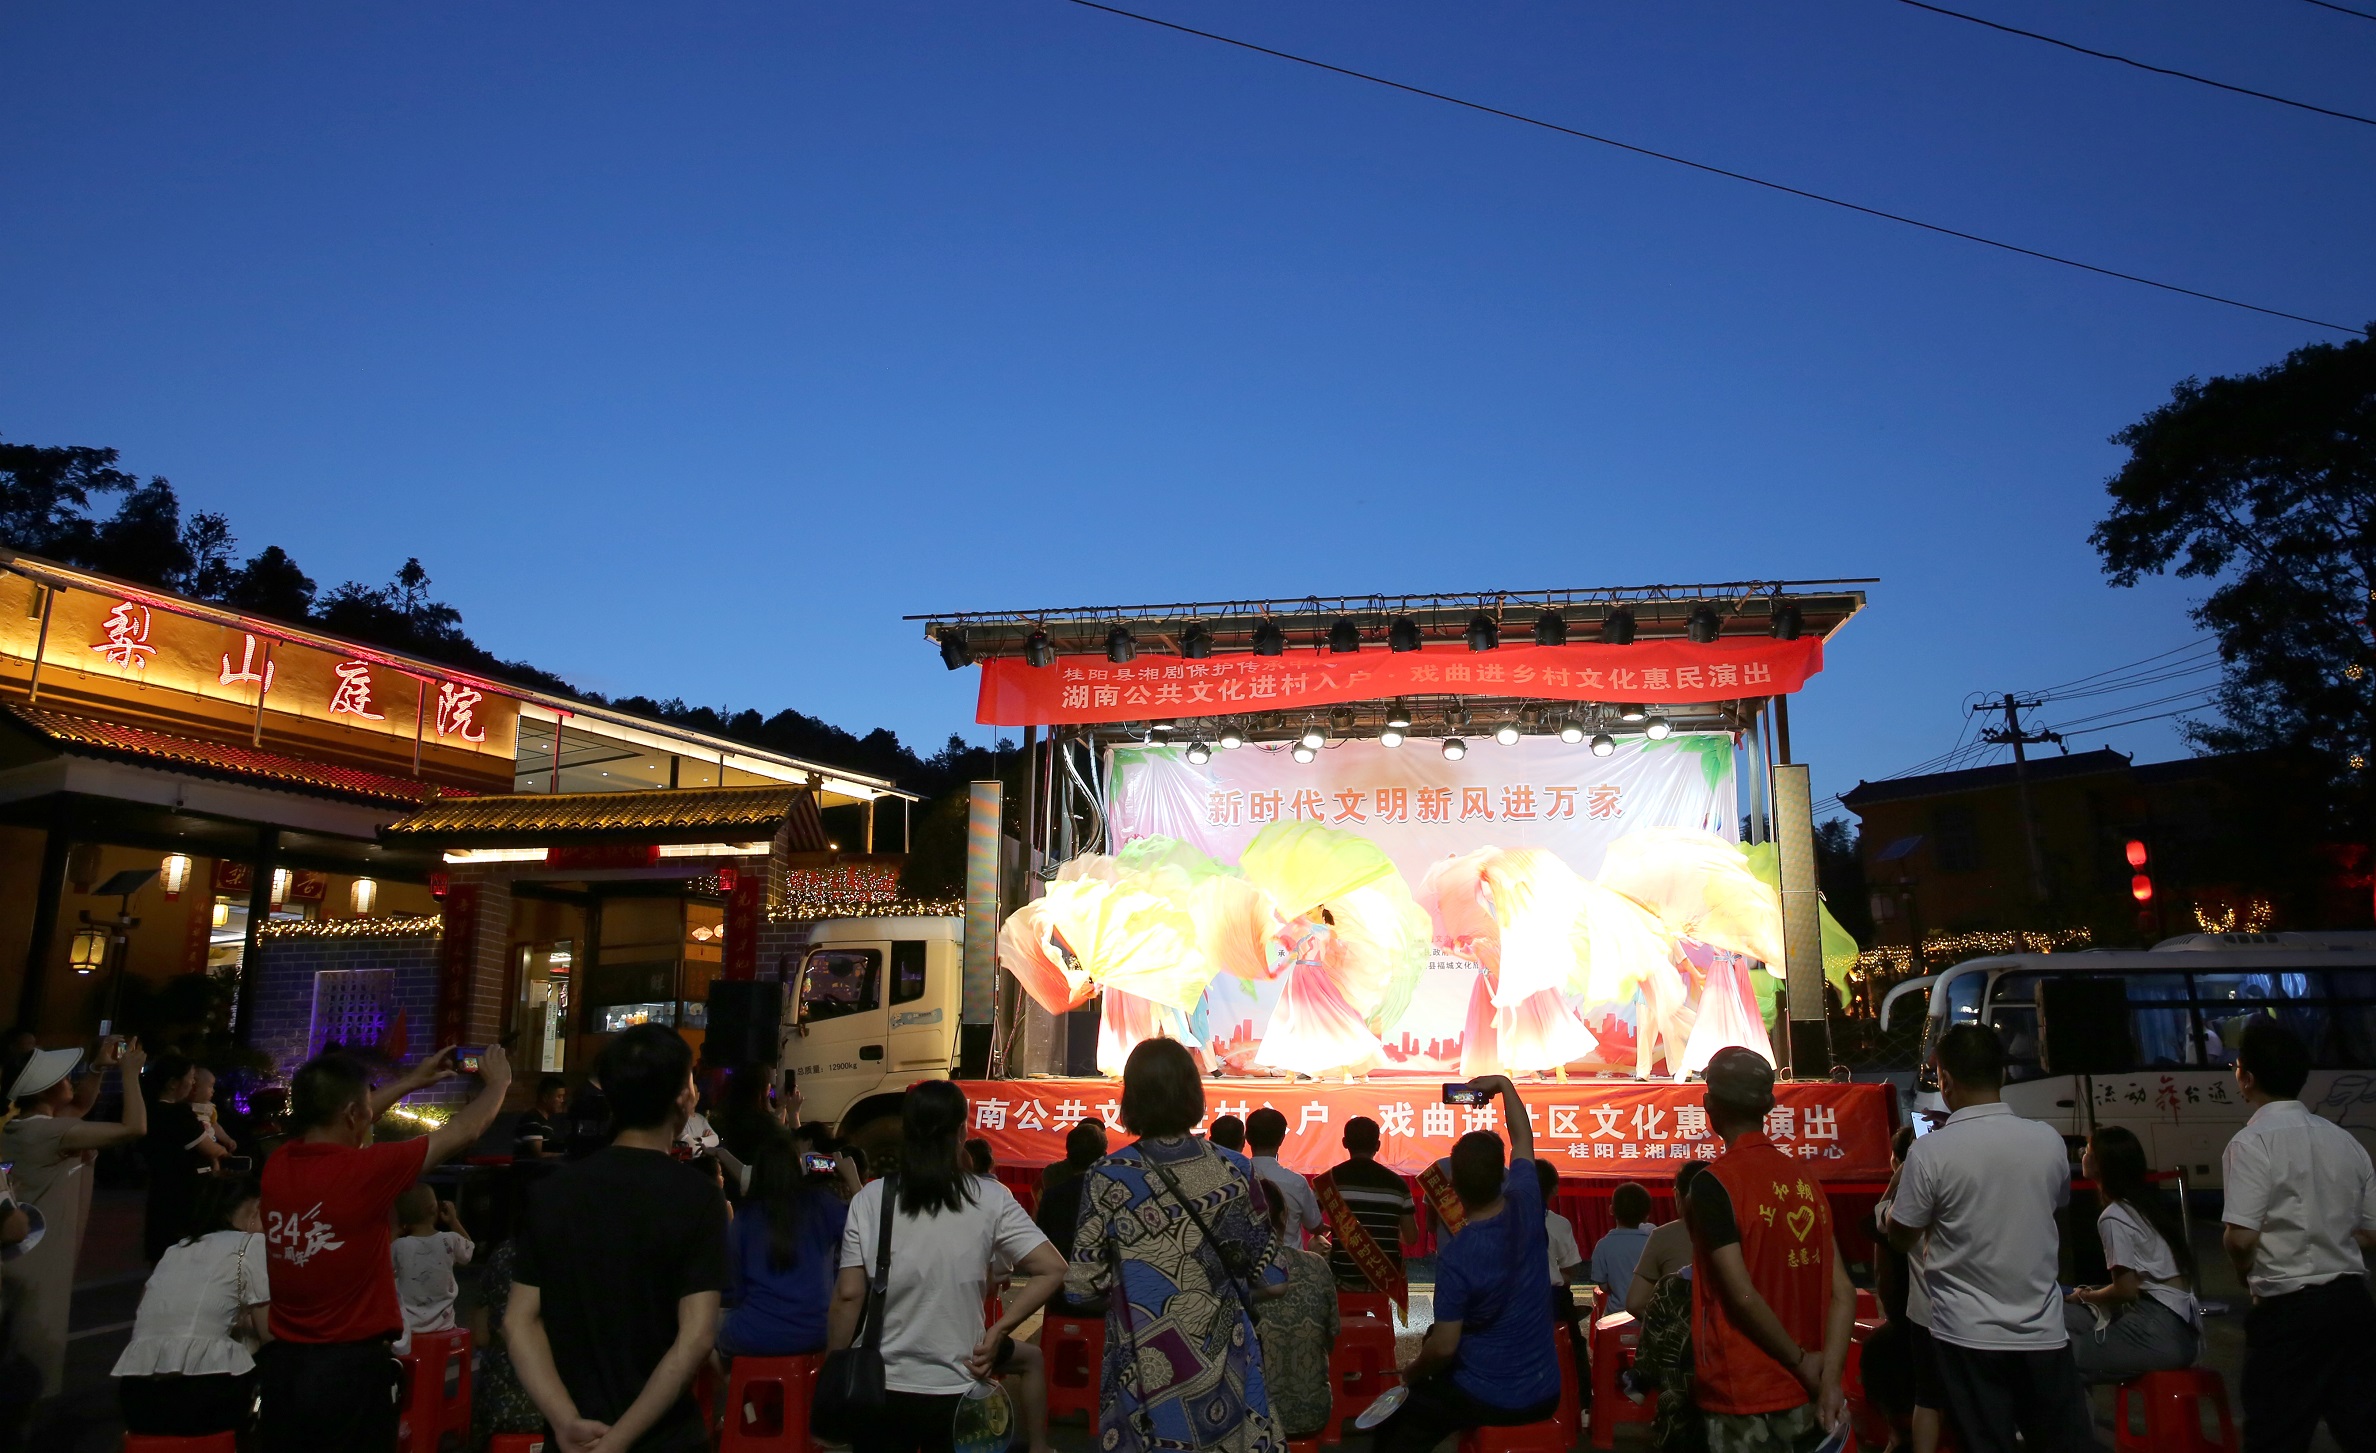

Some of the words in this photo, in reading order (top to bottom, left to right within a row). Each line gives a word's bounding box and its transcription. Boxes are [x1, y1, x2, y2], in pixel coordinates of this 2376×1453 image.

[1206, 785, 1626, 826] 新时代文明新风进万家
[2095, 1075, 2250, 1127] 流动舞台通
[268, 1211, 300, 1245] 24
